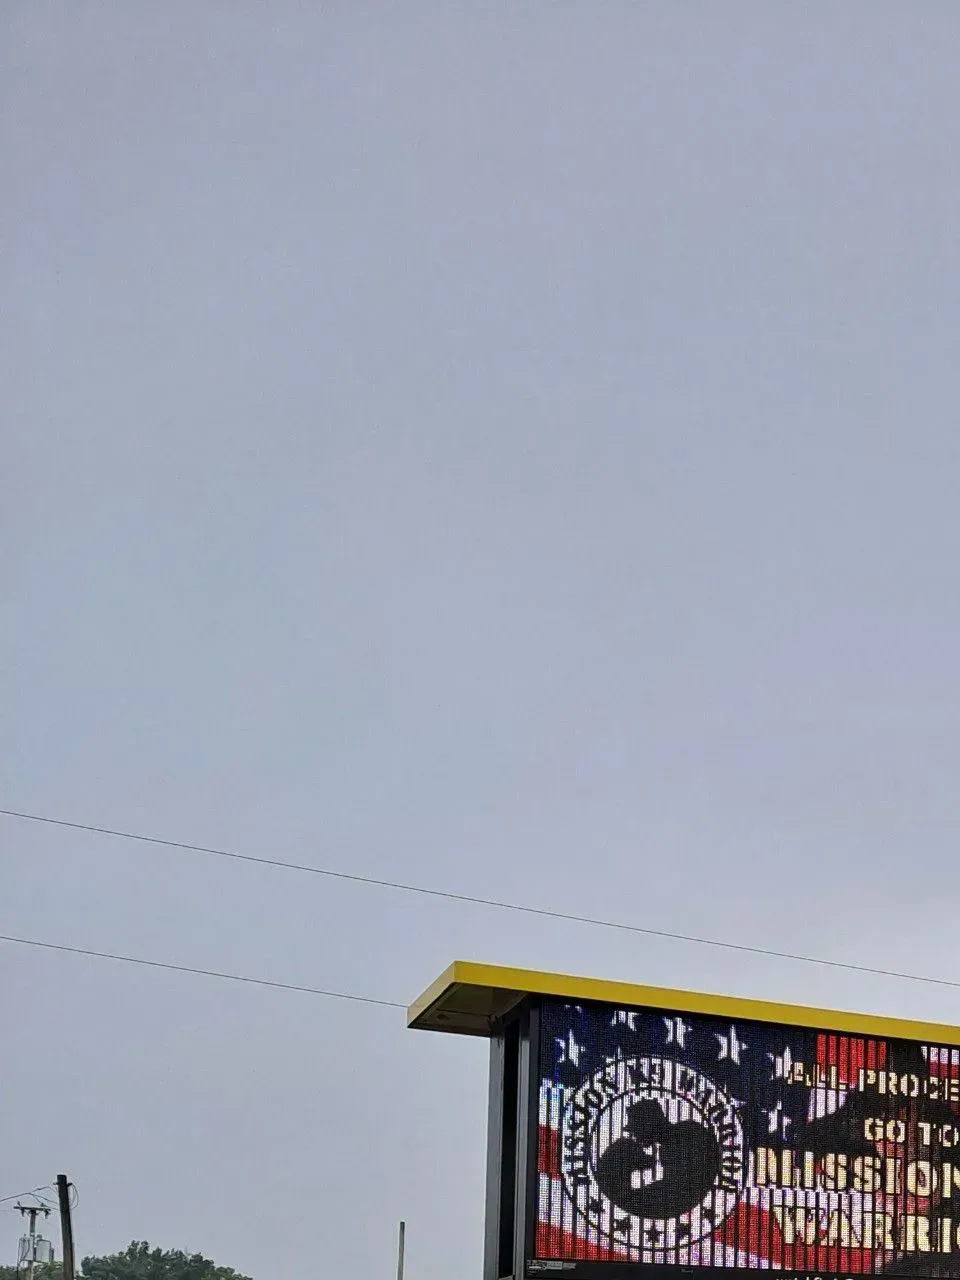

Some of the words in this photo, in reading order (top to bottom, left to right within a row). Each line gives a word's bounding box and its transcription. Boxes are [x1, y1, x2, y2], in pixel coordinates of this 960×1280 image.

[787, 1061, 847, 1092] ALL
[864, 1117, 905, 1143] GO
[917, 1121, 960, 1148] TO
